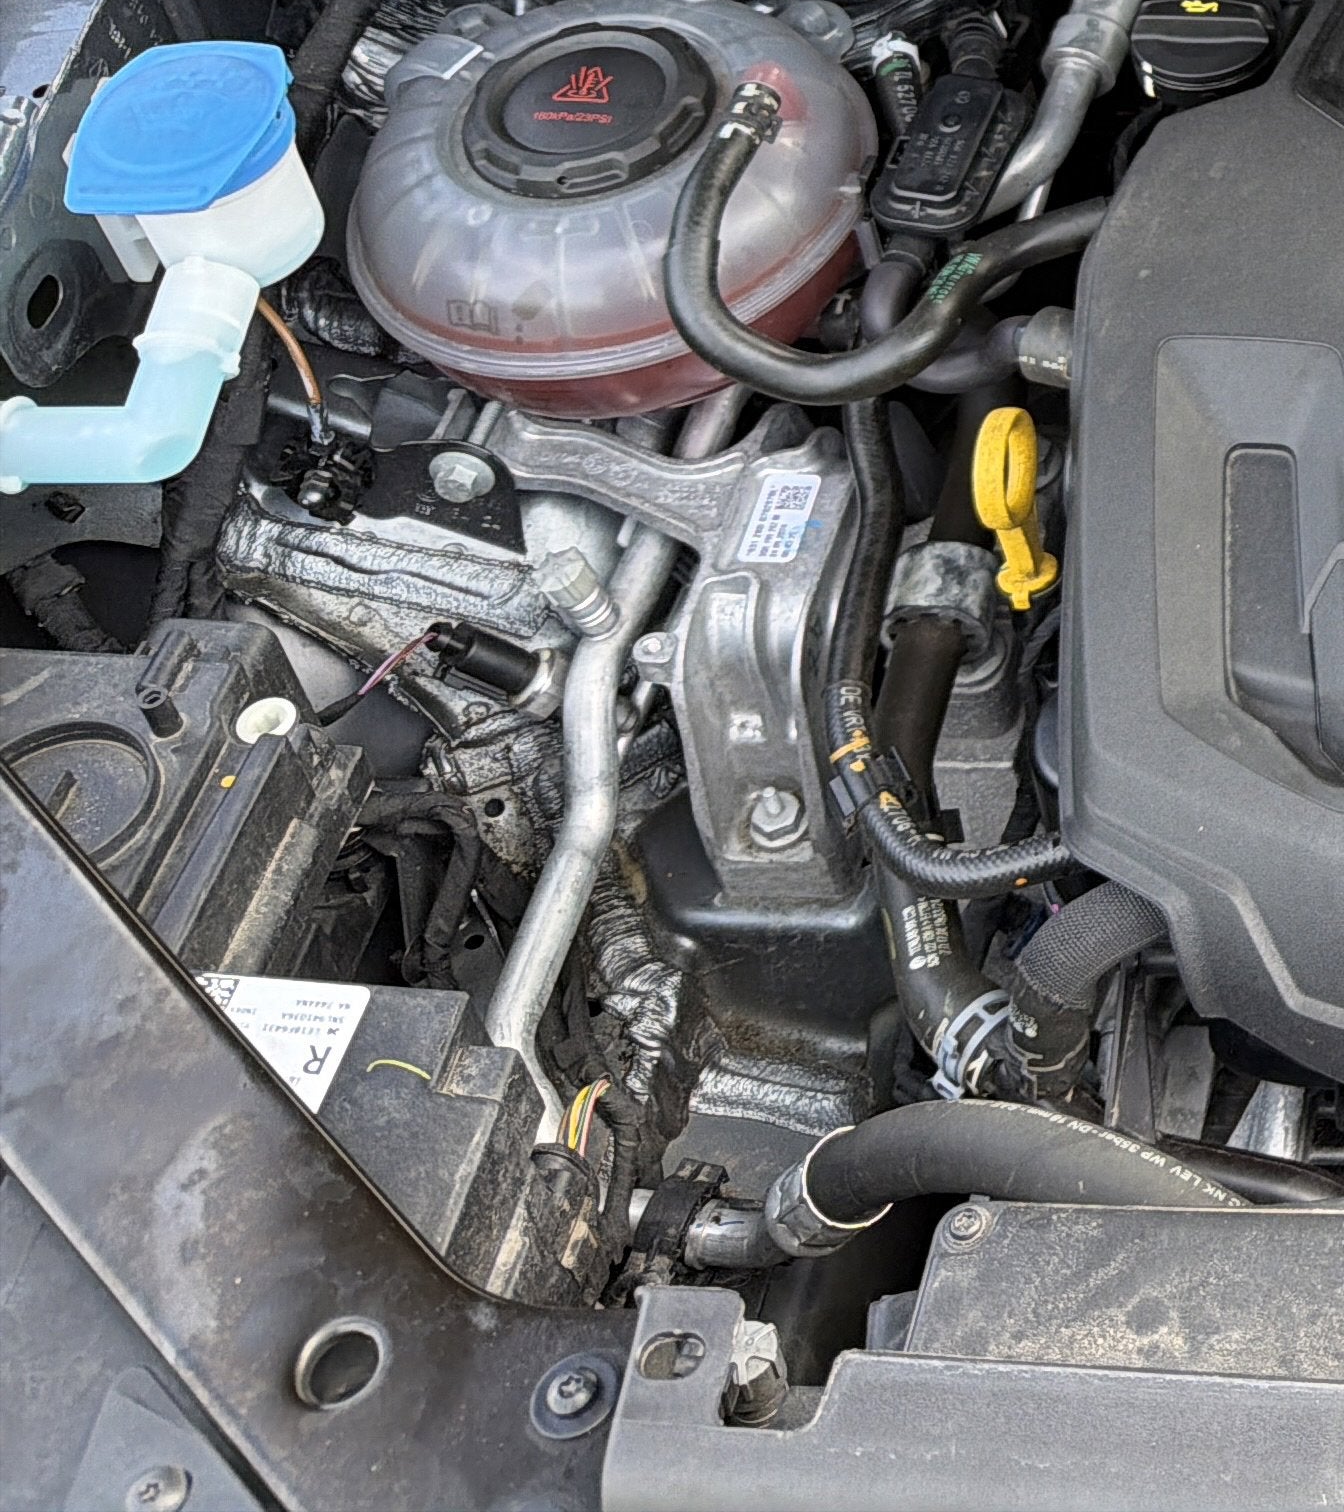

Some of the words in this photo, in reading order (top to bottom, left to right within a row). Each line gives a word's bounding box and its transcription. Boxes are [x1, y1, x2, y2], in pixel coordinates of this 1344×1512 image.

[532, 110, 614, 125] 160kPa/23PSI
[302, 1044, 332, 1075] R
[1139, 1148, 1166, 1167] WP
[1168, 1162, 1202, 1187] LEV
[1201, 1180, 1227, 1203] NK
